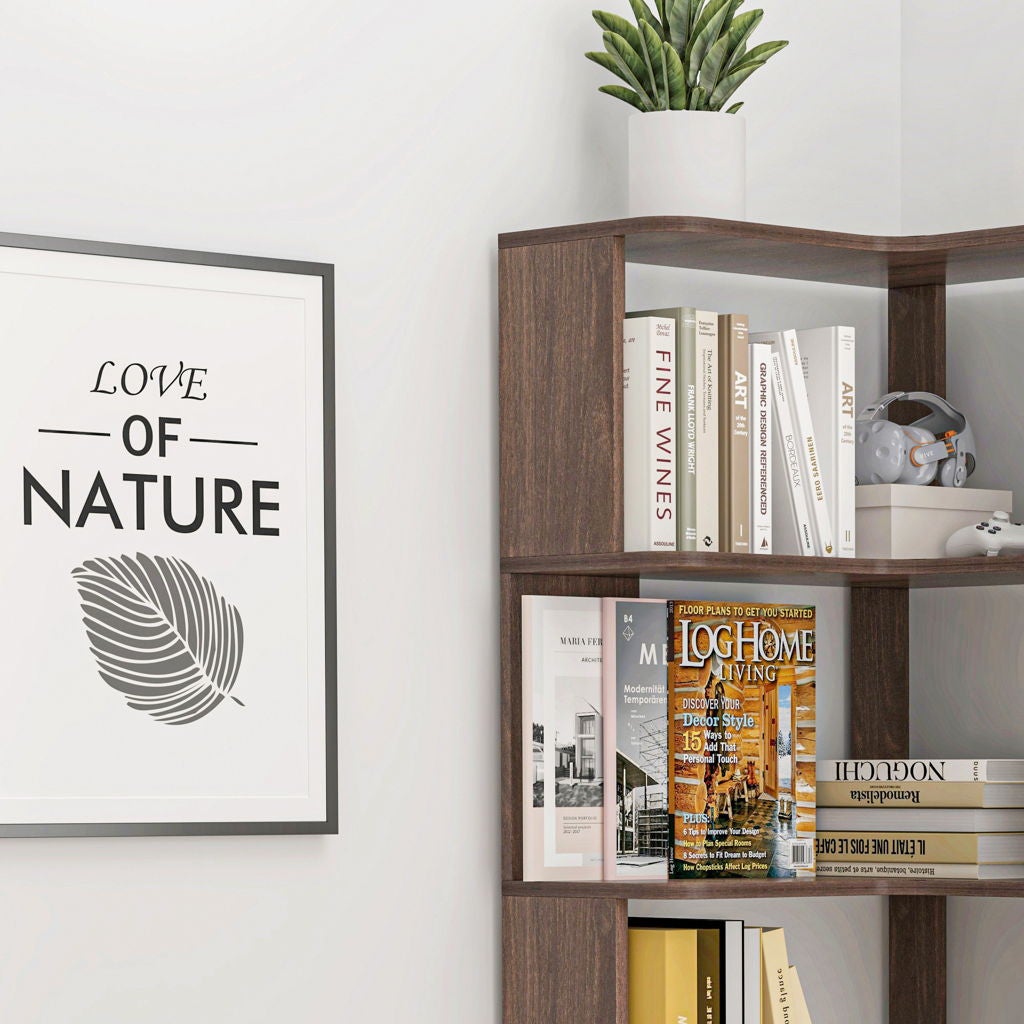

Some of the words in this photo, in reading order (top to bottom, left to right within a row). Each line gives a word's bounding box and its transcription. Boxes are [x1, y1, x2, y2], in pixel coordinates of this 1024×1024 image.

[90, 361, 207, 400] LOVE
[656, 350, 672, 412] FINE
[688, 384, 696, 412] FRANK
[735, 371, 747, 409] ART
[841, 381, 853, 419] ART
[122, 414, 181, 457] OF
[688, 441, 696, 473] WRIGHT
[785, 434, 800, 488] BORDEAUX
[656, 427, 672, 519] WINES
[23, 466, 279, 536] NATURE
[679, 605, 704, 615] FLOOR
[706, 606, 731, 616] PLANS
[734, 606, 744, 616] TO
[745, 607, 760, 617] GET
[762, 607, 778, 618] YOU
[780, 608, 813, 618] STARTED
[719, 664, 777, 682] LIVING
[683, 698, 719, 709] DISCOVER
[720, 697, 740, 710] YOUR
[682, 713, 719, 727] Decor
[722, 713, 754, 731] Style
[682, 730, 702, 751] 15
[703, 730, 722, 741] Ways
[725, 731, 732, 740] to
[704, 742, 718, 751] Add
[720, 742, 736, 751] That
[683, 754, 714, 763] Personal
[717, 754, 738, 763] Touch
[835, 761, 946, 781] NOGUCHI
[850, 790, 921, 804] Remodelista
[683, 813, 710, 824] PLUS:
[707, 828, 728, 837] Improve
[742, 828, 760, 836] Design
[715, 840, 733, 848] Special
[748, 851, 767, 859] Budget
[695, 863, 723, 872] Chopsticks
[724, 863, 740, 871] Affect
[741, 863, 750, 871] Log
